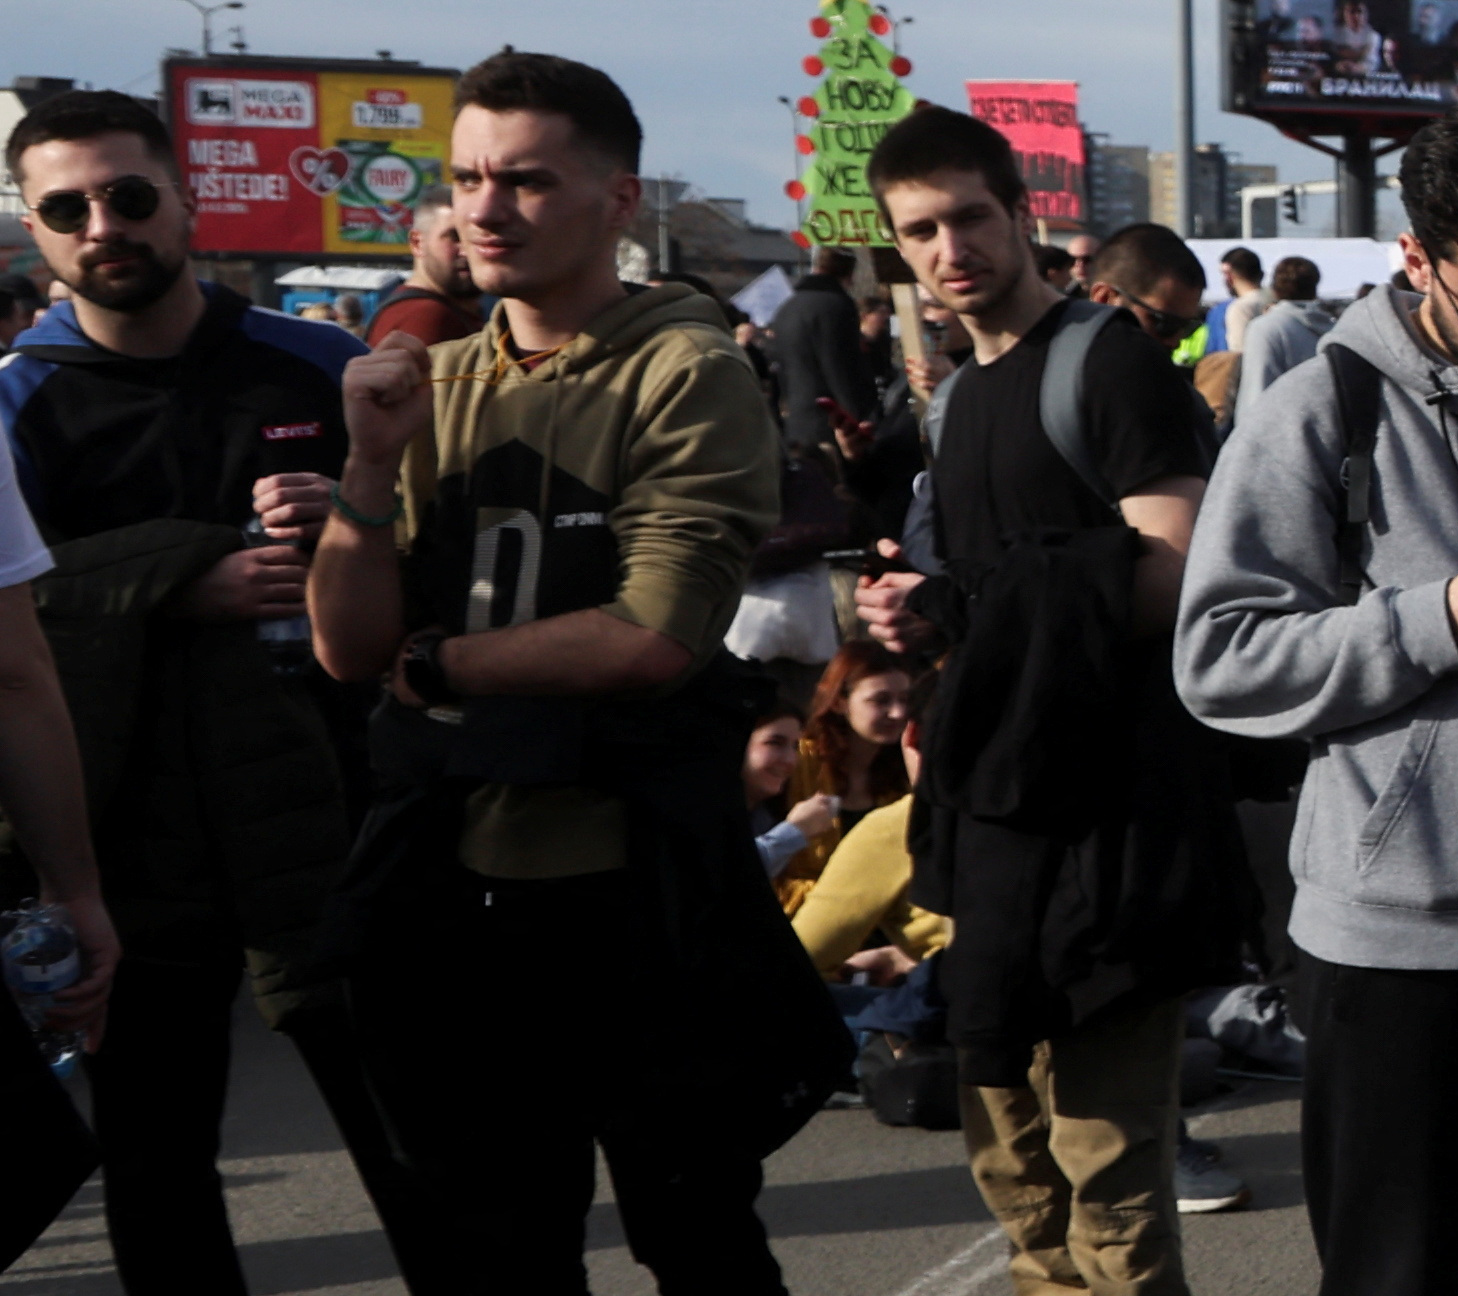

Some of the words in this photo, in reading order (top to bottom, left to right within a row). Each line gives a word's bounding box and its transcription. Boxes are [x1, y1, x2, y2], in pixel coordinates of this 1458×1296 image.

[832, 38, 881, 70] ЗА
[241, 88, 301, 103] MEGA
[826, 79, 899, 111] НОВУ
[1321, 77, 1442, 102] БРАНИЛАЦ
[188, 139, 258, 166] MEGA
[820, 119, 889, 154] ГОДИ
[189, 167, 290, 200] UŠTEDE!
